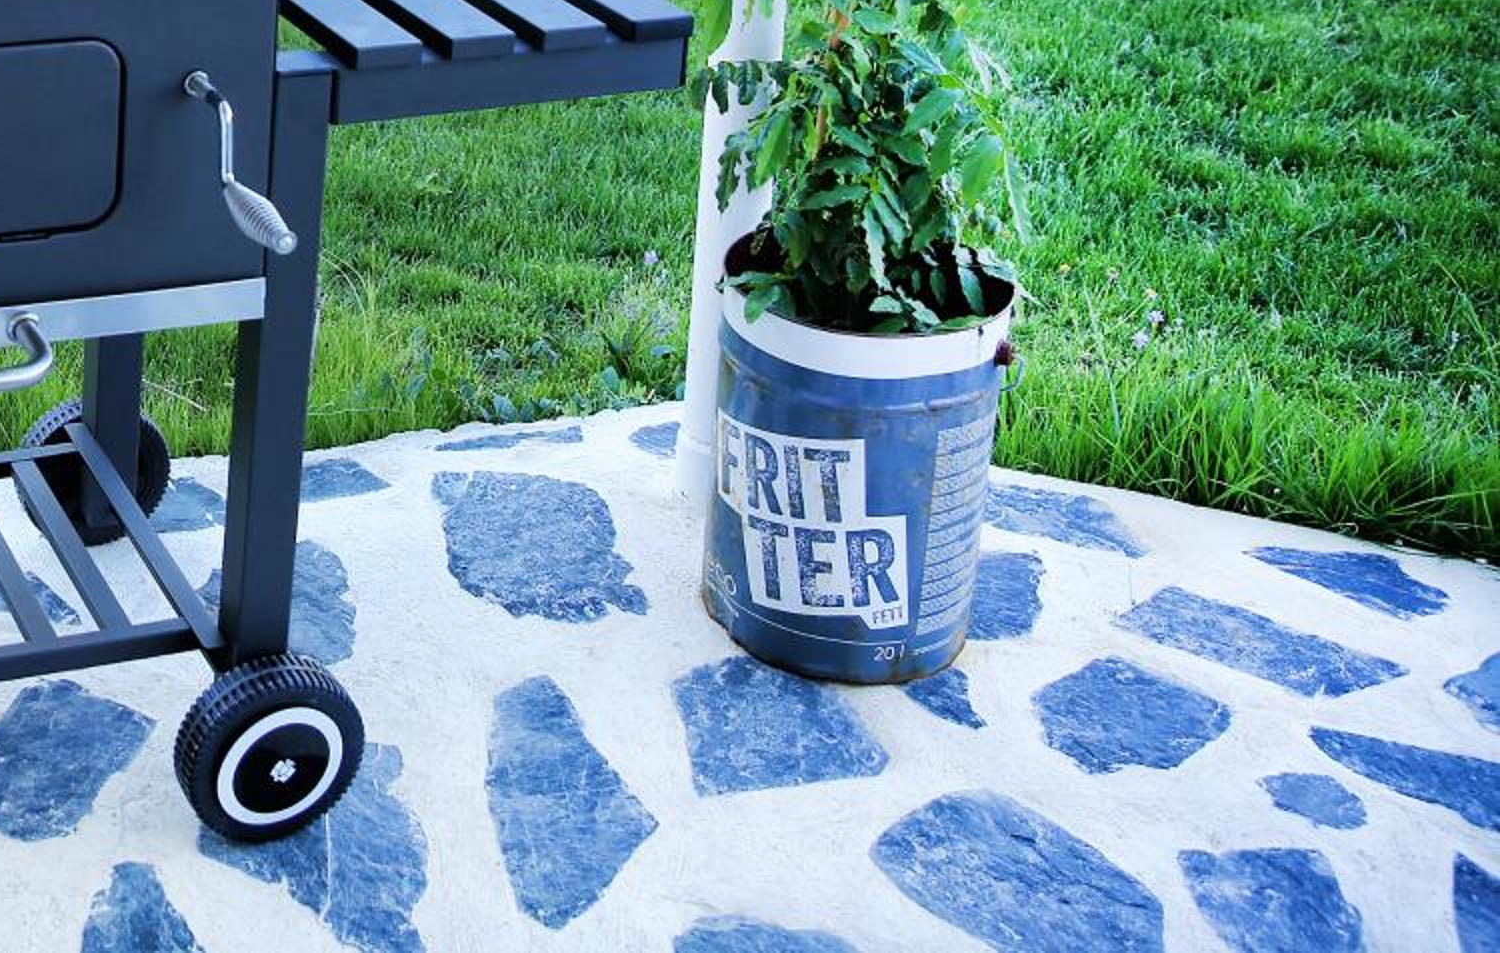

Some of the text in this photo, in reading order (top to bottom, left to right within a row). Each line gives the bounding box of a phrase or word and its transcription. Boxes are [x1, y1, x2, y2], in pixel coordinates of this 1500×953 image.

[721, 419, 851, 524] FRIT
[748, 513, 900, 608] TER
[872, 606, 903, 624] FETT
[873, 646, 895, 663] 20
